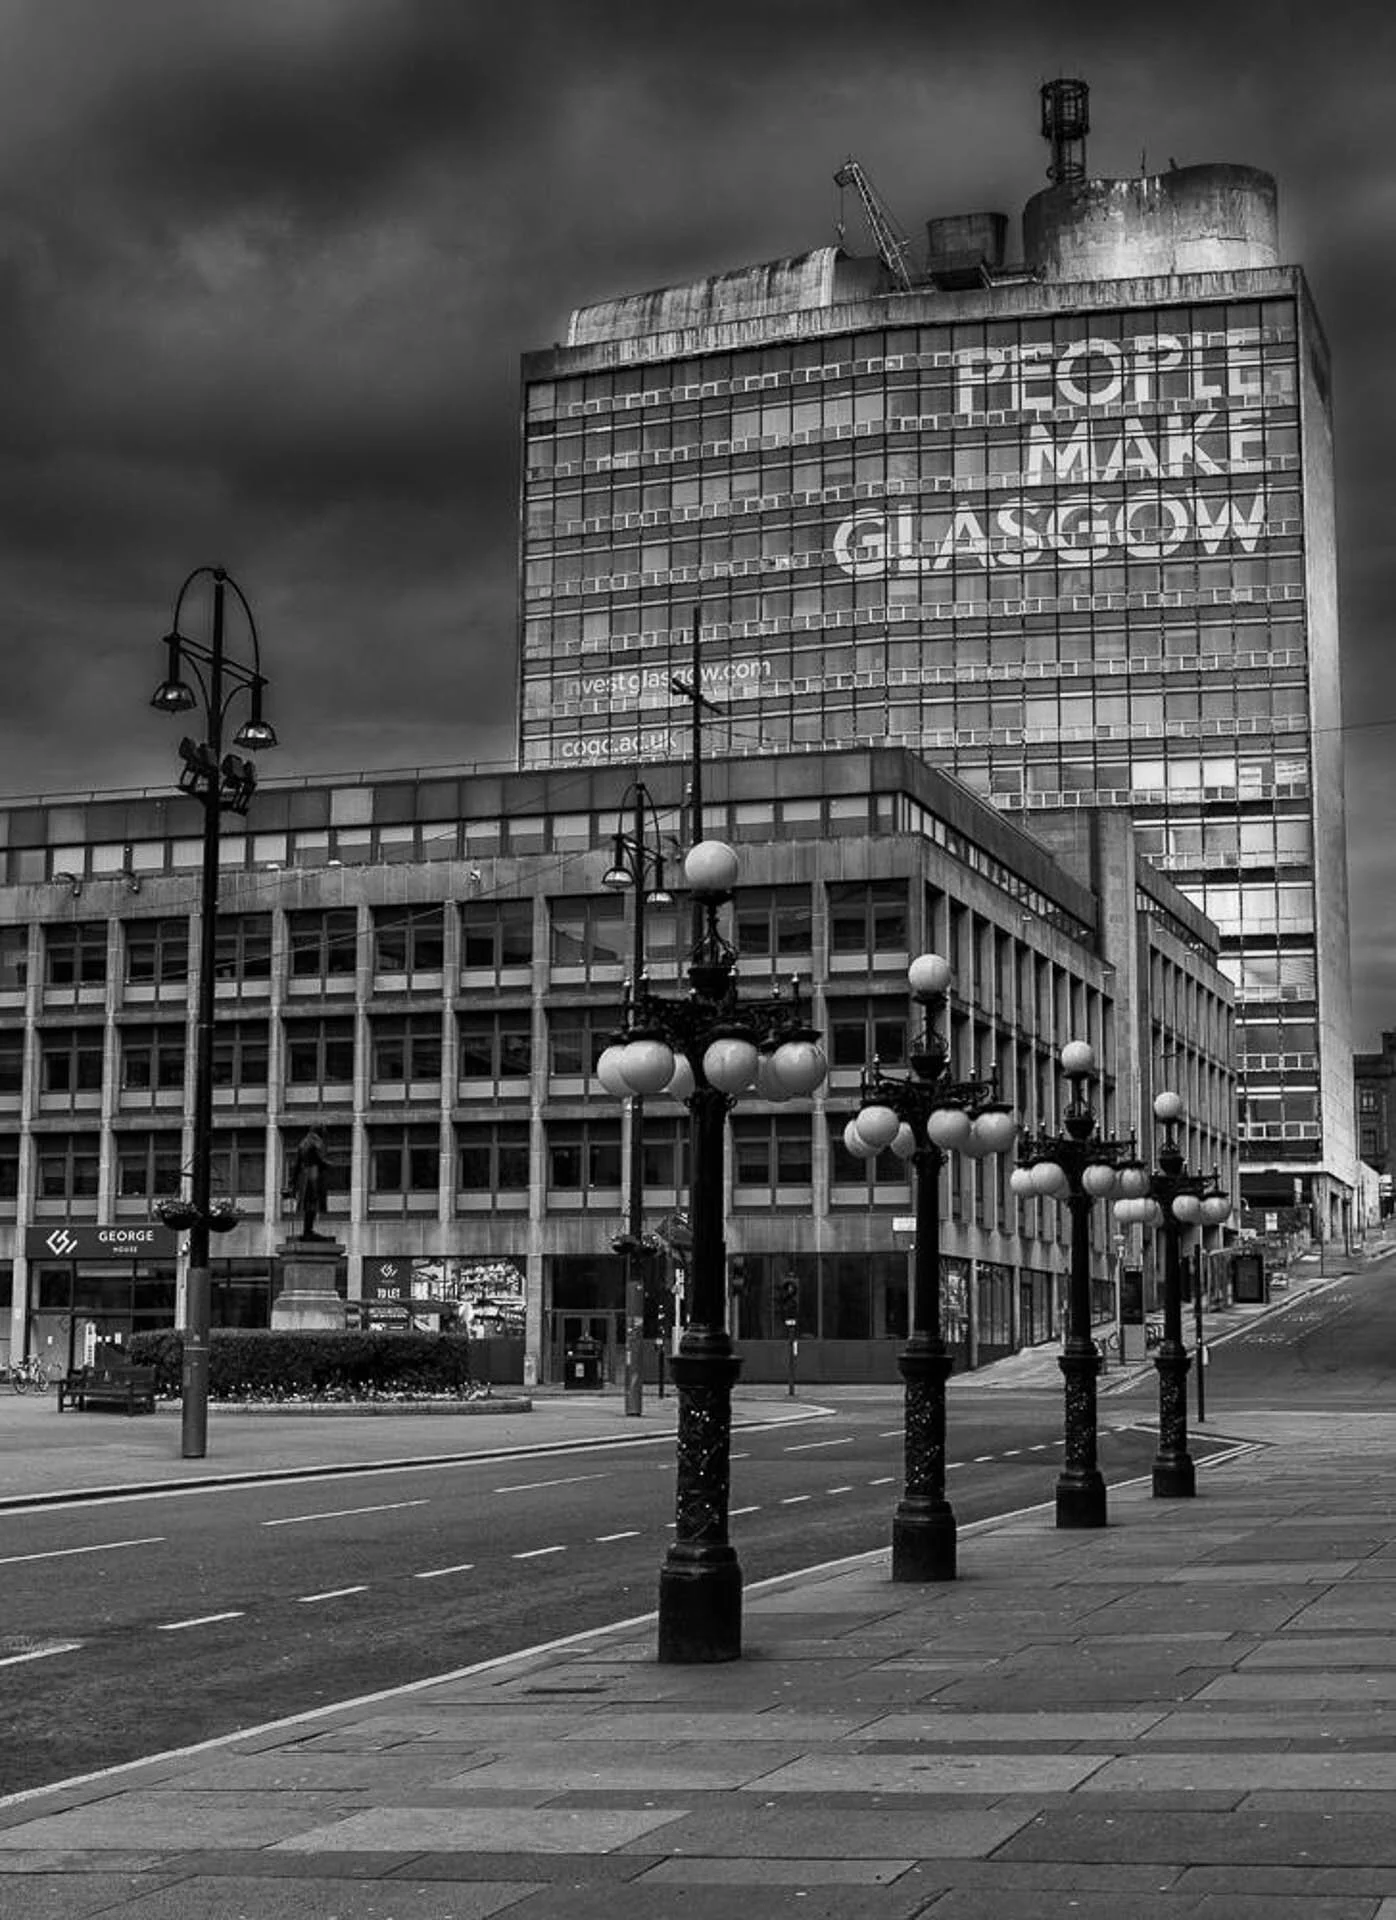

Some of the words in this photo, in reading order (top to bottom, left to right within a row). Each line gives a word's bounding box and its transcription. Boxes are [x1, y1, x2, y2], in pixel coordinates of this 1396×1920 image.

[955, 327, 1269, 415] PEOPLE
[1026, 410, 1268, 486] MAKE
[832, 482, 1272, 577] GLASGOW
[565, 660, 771, 695] nvestglasgow.com
[98, 1229, 154, 1243] GEORGE
